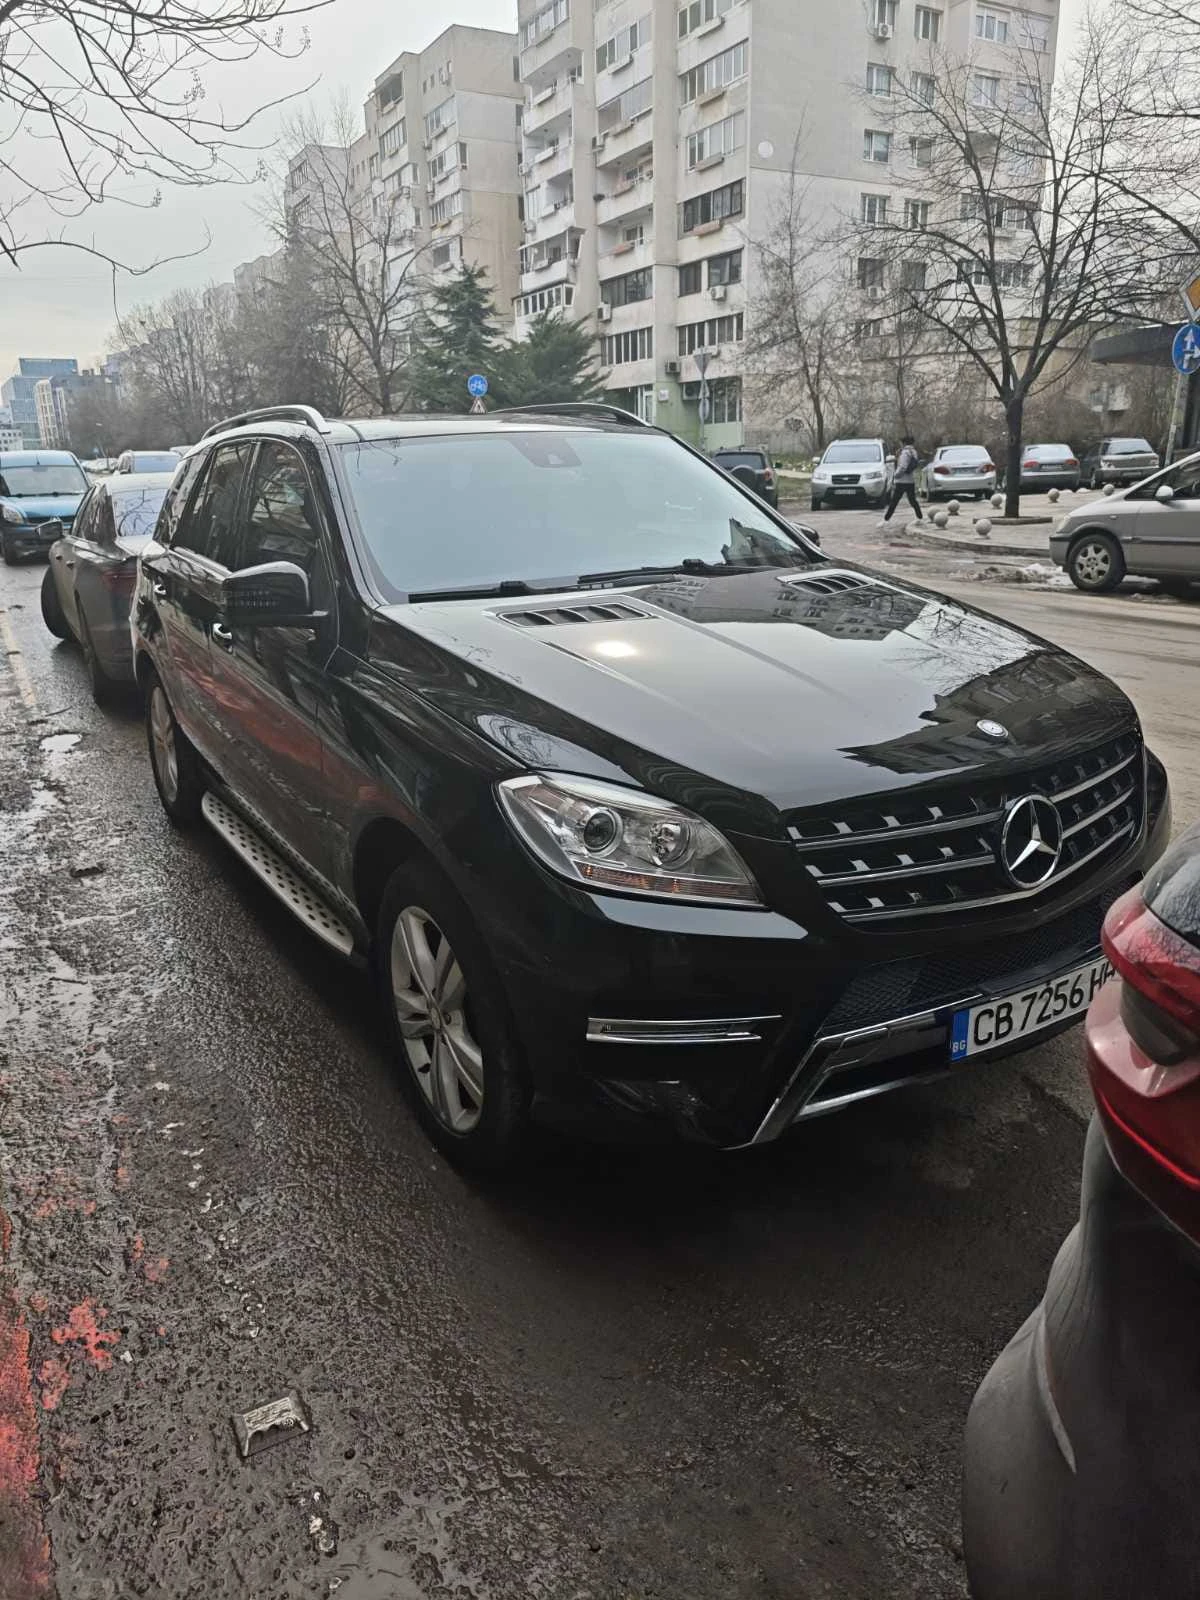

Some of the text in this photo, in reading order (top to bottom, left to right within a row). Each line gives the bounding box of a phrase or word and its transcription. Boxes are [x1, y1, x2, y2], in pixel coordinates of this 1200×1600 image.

[973, 1002, 1013, 1046] CB
[1019, 973, 1084, 1031] 7256
[952, 1039, 966, 1053] BG
